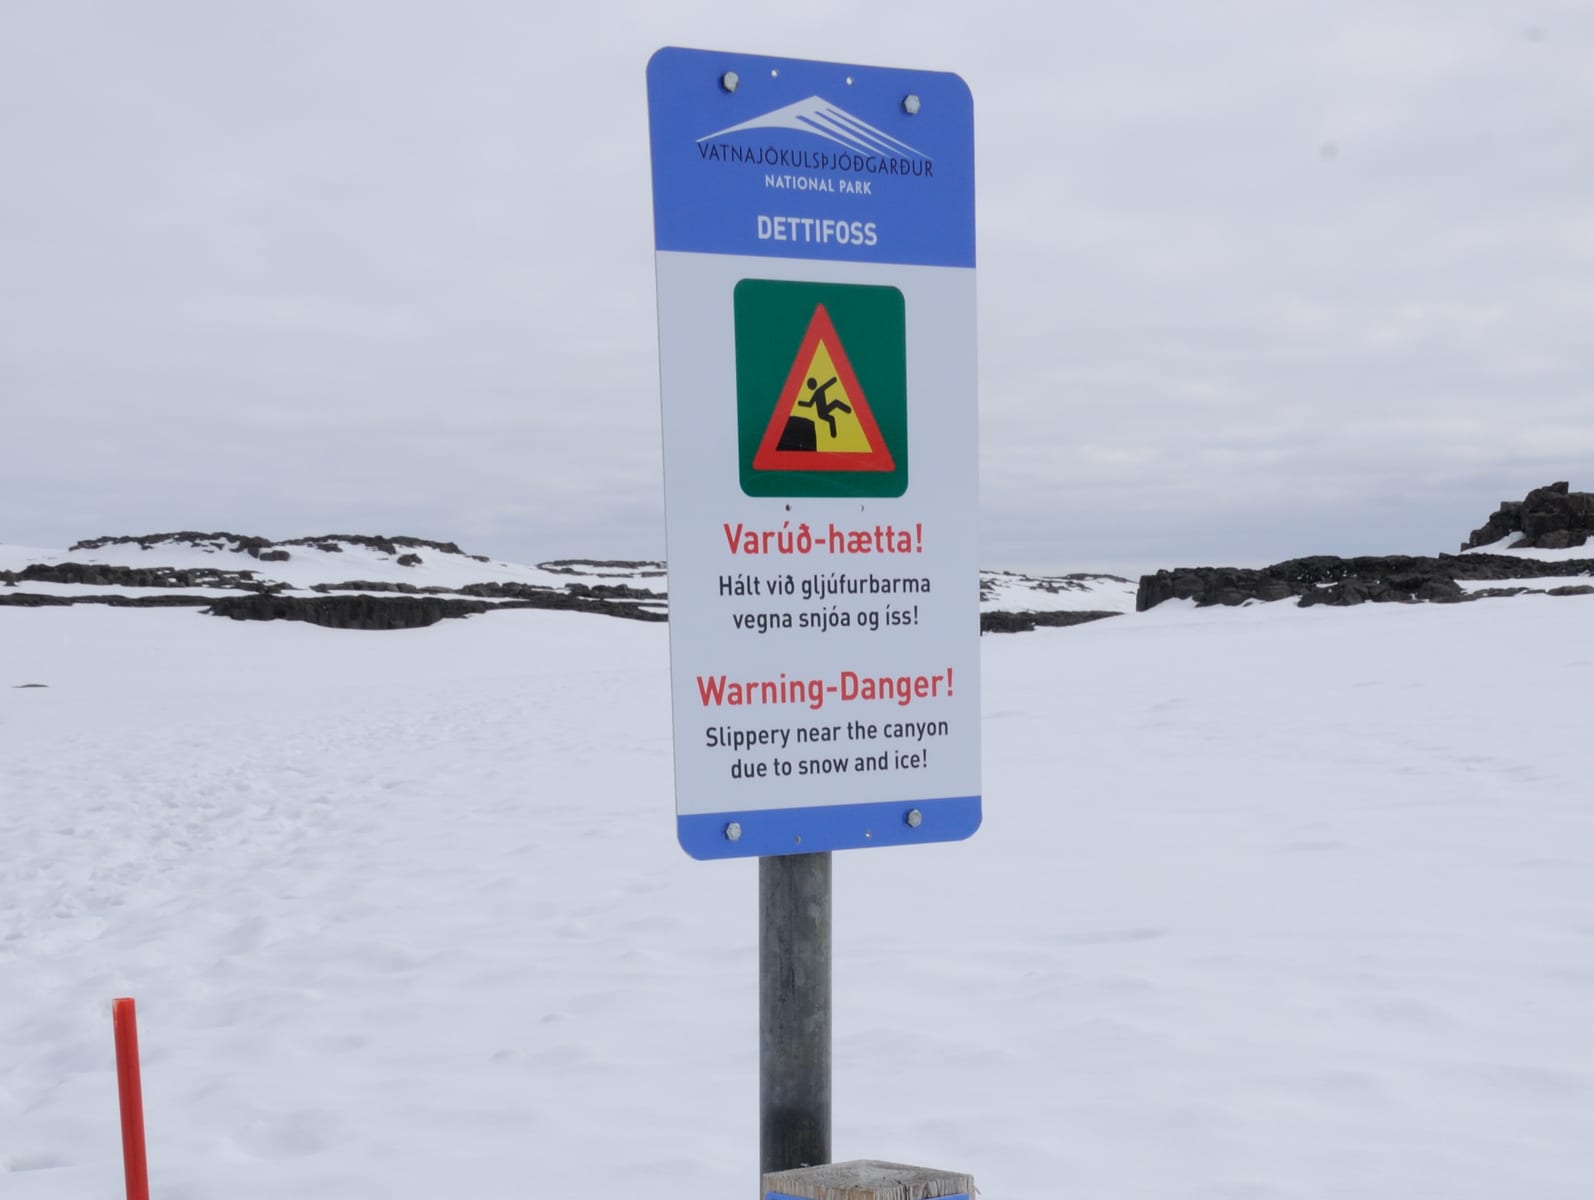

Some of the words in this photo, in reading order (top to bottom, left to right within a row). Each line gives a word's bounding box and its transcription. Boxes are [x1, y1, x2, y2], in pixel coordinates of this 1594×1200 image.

[697, 142, 934, 177] VATNAJÖKULSÞJÓÐGARÐUR
[765, 174, 835, 193] NATIONAL
[839, 179, 872, 195] PARK
[757, 215, 878, 246] DETTIFOSS
[723, 521, 923, 554] Varúð-hætta!
[718, 573, 761, 596] Hált
[766, 574, 795, 596] við
[801, 572, 931, 600] gljúfurbarma
[732, 611, 793, 634] vegna
[799, 605, 851, 632] snjóa
[857, 610, 880, 631] og
[885, 604, 919, 626] íss!
[696, 667, 954, 710] Warning-Danger!
[706, 726, 790, 751] Slippery
[797, 726, 842, 743] near
[847, 720, 878, 740] the
[883, 721, 949, 742] canyon
[731, 759, 768, 779] due
[774, 757, 792, 776] to
[798, 756, 849, 775] snow
[853, 751, 889, 772] and
[895, 748, 928, 770] ice!
